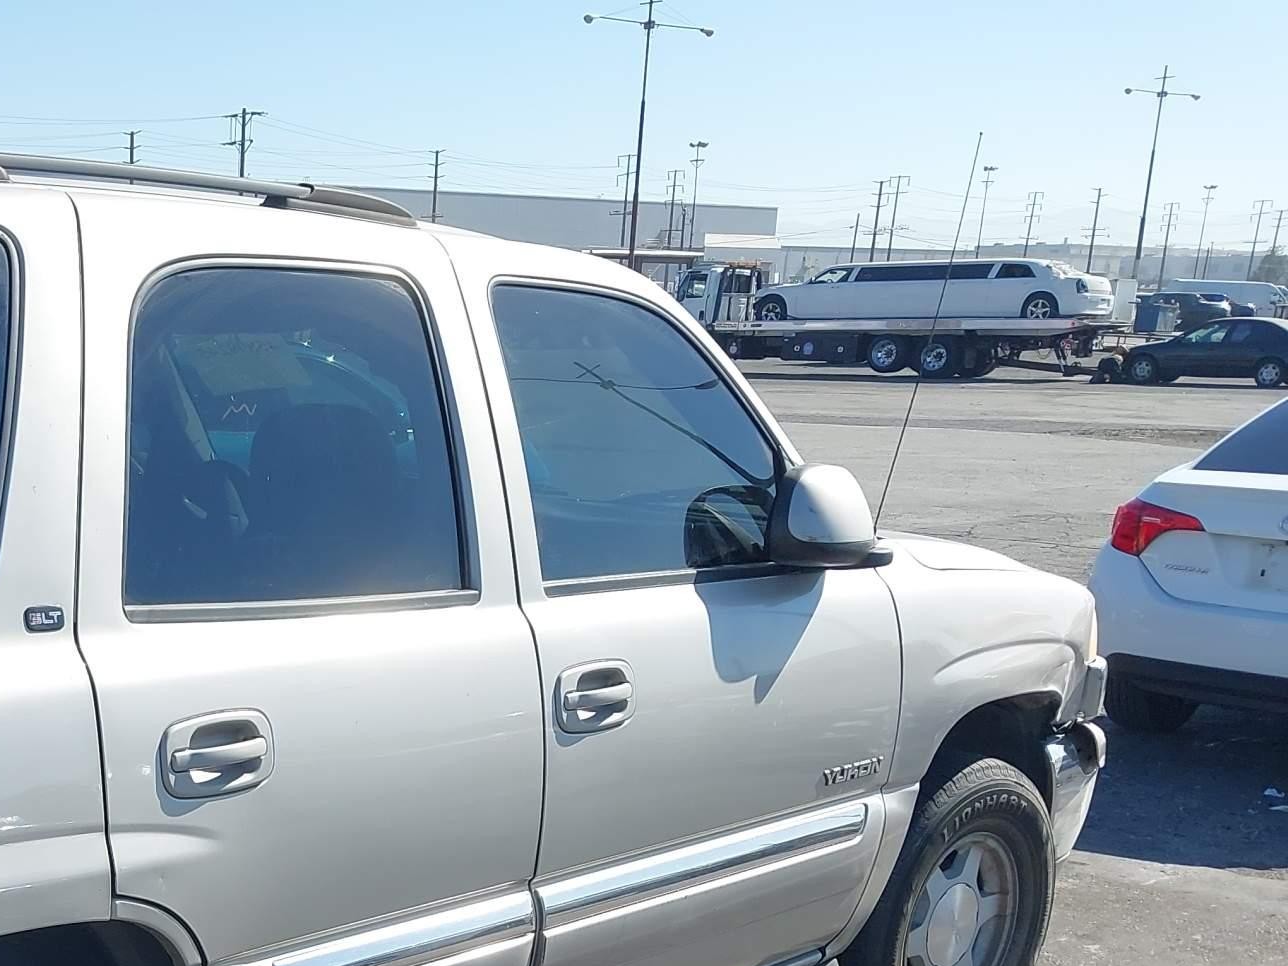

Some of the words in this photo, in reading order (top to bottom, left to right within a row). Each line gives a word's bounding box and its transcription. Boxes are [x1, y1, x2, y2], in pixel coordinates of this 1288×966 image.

[28, 611, 62, 626] SLT
[823, 756, 884, 786] YUKON
[943, 793, 1028, 843] LIONHART
